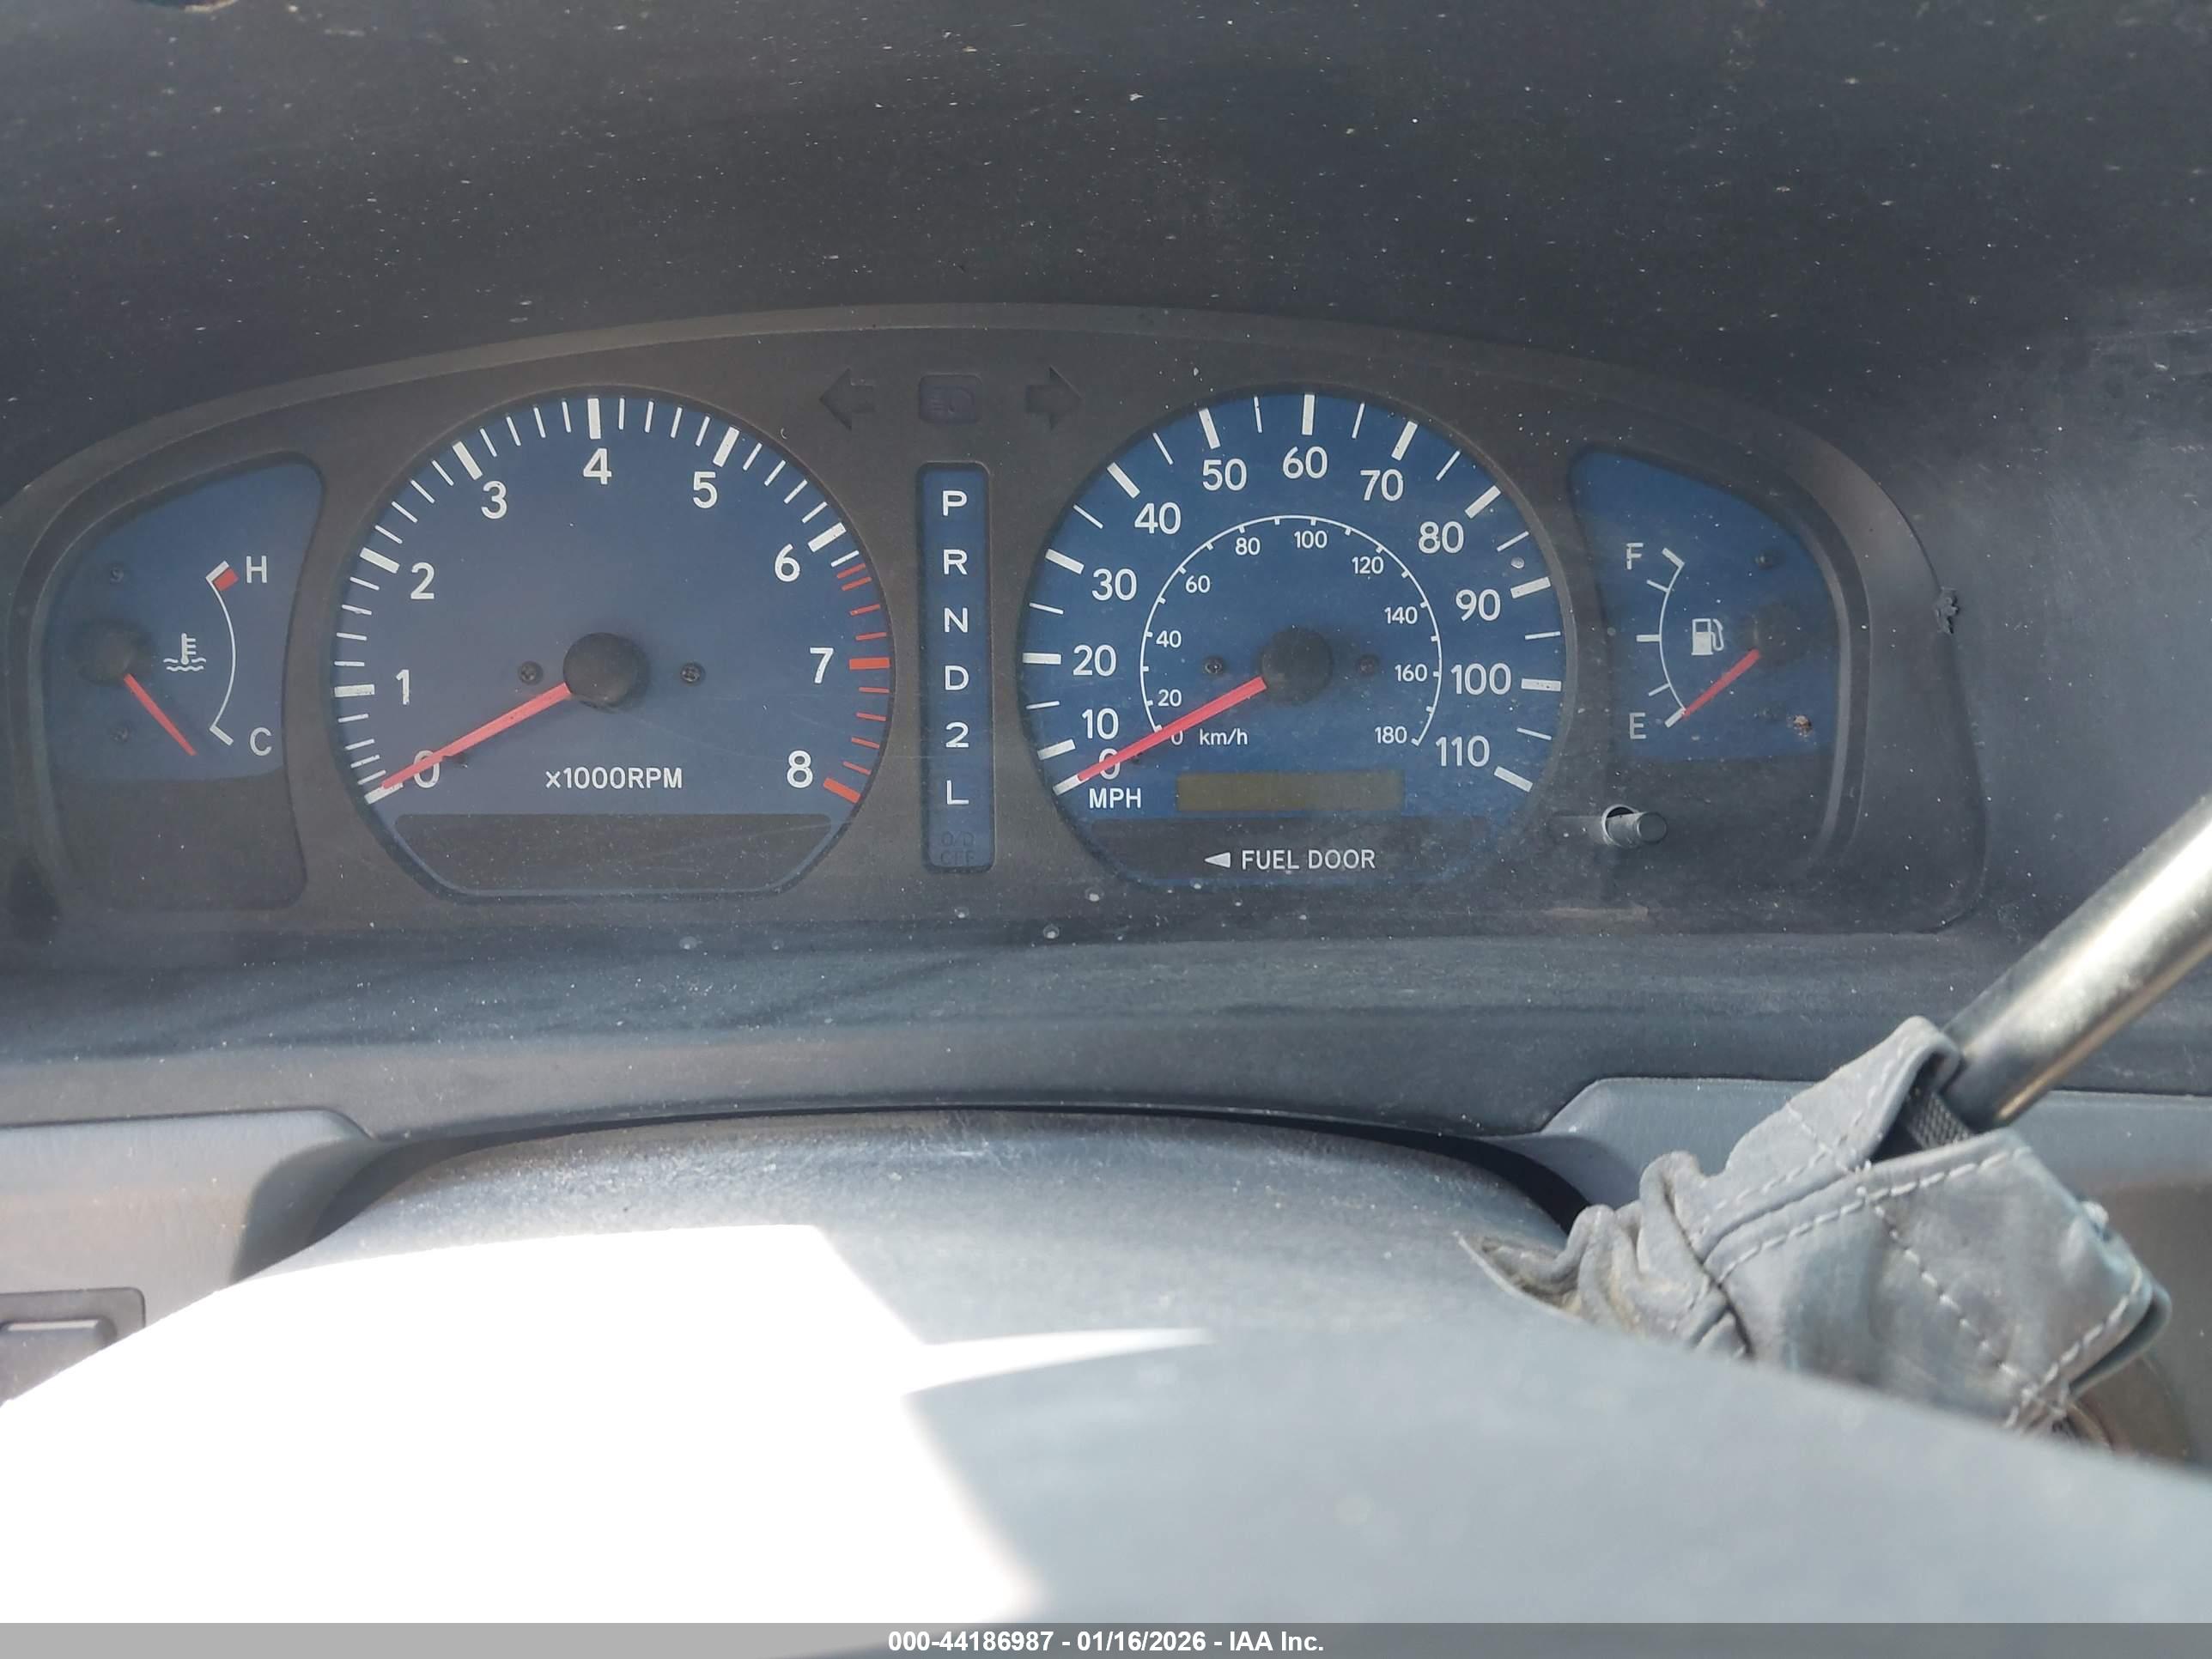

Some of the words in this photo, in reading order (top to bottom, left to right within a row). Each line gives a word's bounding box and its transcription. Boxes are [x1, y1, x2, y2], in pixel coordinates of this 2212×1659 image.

[583, 447, 612, 485] 4
[1202, 458, 1247, 491] 50
[1282, 446, 1328, 479] 60
[481, 480, 507, 520] 3
[693, 471, 718, 509] 5
[1360, 469, 1404, 501] 70
[942, 489, 968, 516] P
[1134, 501, 1182, 535] 40
[1235, 537, 1261, 556] 80
[1294, 530, 1328, 549] 100
[1418, 520, 1464, 554] 80
[246, 555, 268, 584] H
[775, 544, 800, 582] 6
[943, 549, 968, 575] R
[1352, 556, 1384, 574] 120
[1626, 542, 1644, 570] F
[410, 562, 434, 600] 2
[1091, 568, 1137, 601] 30
[1185, 574, 1211, 593] 60
[944, 607, 969, 633] N
[1384, 606, 1418, 624] 140
[1455, 588, 1501, 622] 90
[1156, 629, 1182, 648] 40
[810, 647, 834, 684] 7
[1073, 644, 1116, 677] 20
[1395, 663, 1428, 682] 160
[396, 669, 410, 705] 1
[945, 665, 969, 690] D
[1450, 663, 1511, 696] 100
[1158, 689, 1182, 707] 20
[945, 721, 969, 748] 2
[1081, 708, 1119, 740] 10
[1200, 727, 1248, 745] km/h
[1374, 726, 1407, 744] 180
[1629, 712, 1647, 739] E
[249, 726, 272, 757] C
[1435, 735, 1490, 768] 110
[414, 750, 440, 788] 0
[545, 766, 683, 789] x1000RPM
[787, 750, 813, 788] 8
[1098, 748, 1121, 780] 0
[946, 780, 969, 805] L
[1089, 787, 1141, 809] MPH
[1242, 849, 1300, 869] FUEL
[1308, 848, 1376, 869] DOOR
